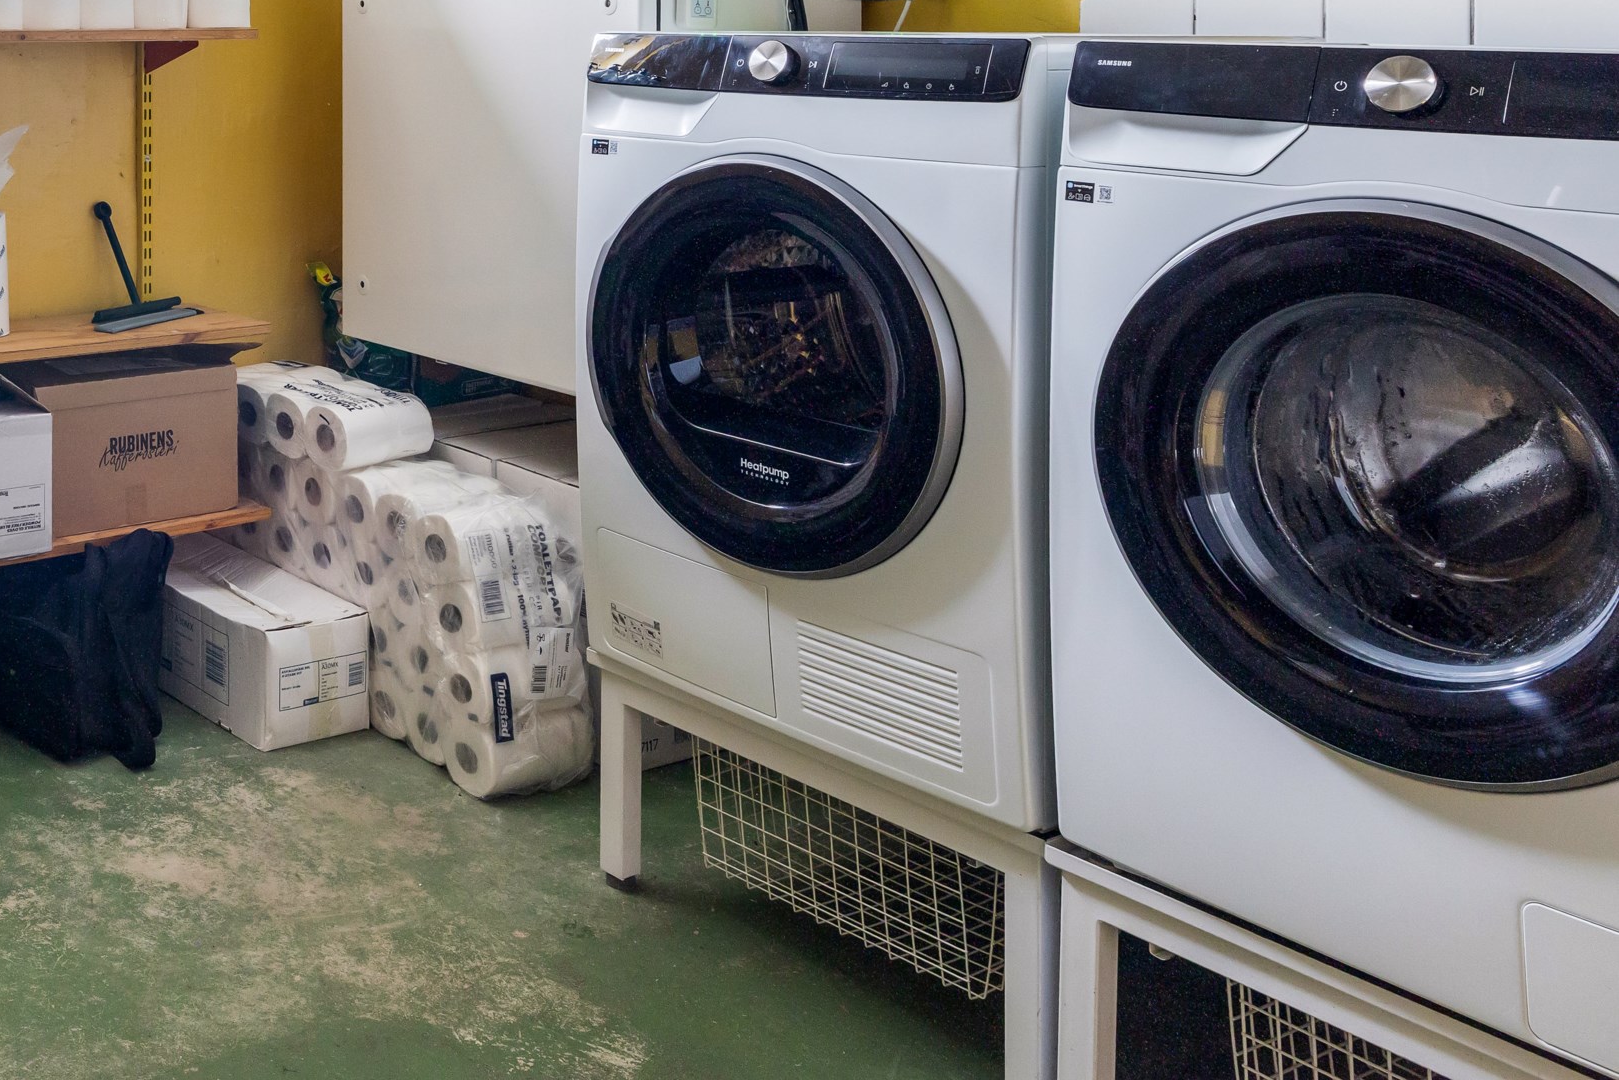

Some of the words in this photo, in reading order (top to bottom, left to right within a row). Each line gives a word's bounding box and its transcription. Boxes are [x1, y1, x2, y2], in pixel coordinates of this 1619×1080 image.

[109, 429, 174, 455] RUBINENS
[740, 457, 790, 480] Heatpump
[497, 678, 511, 737] Tingstad
